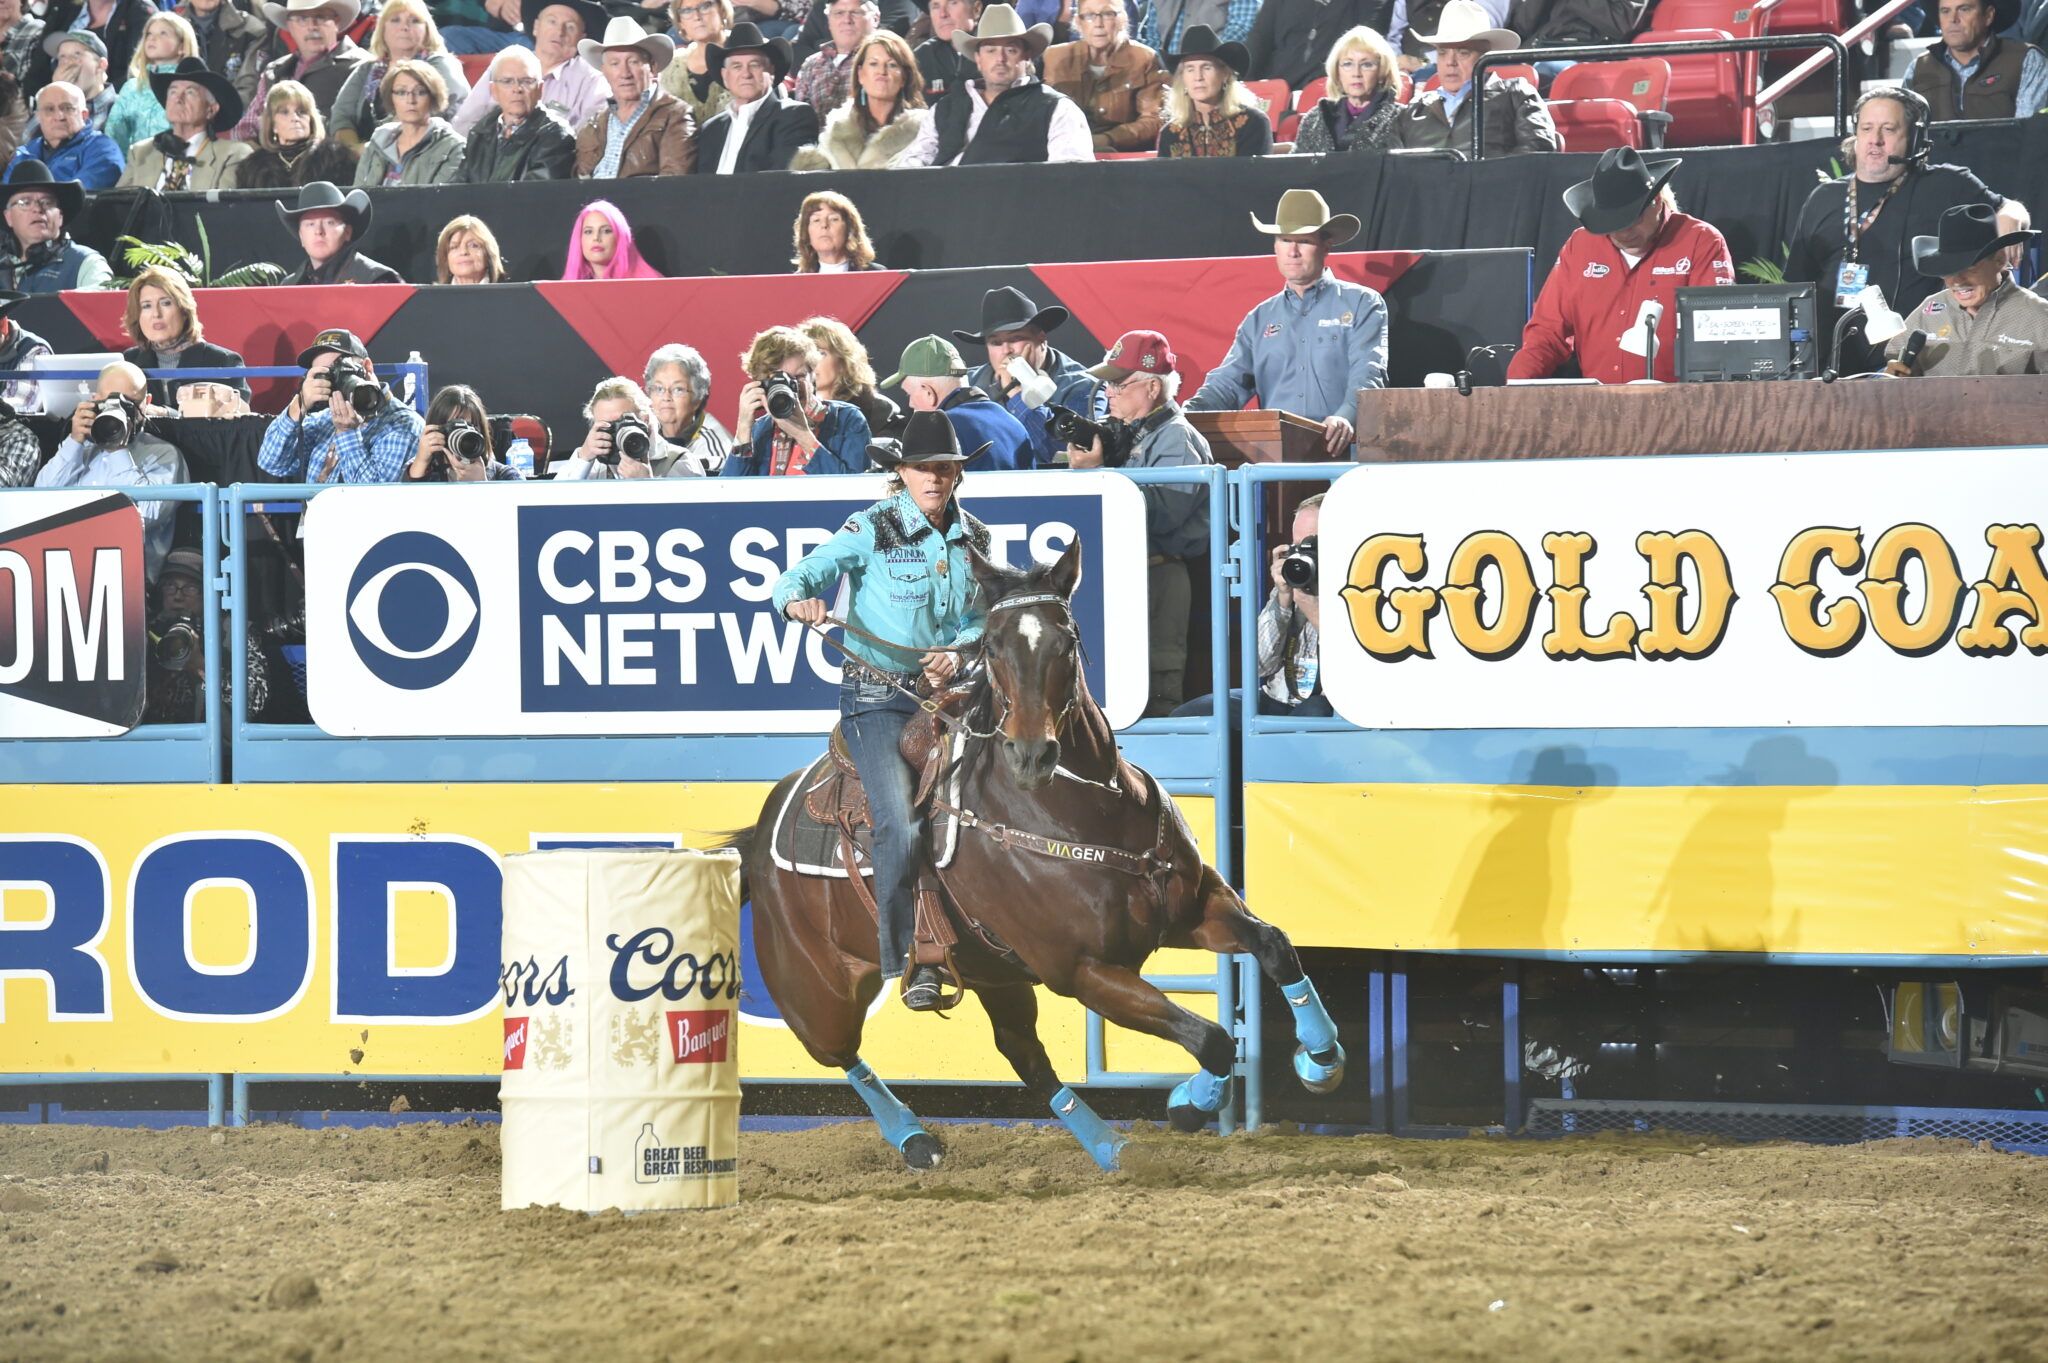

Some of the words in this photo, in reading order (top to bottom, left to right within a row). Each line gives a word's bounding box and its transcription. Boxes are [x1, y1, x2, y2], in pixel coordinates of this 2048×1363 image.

[538, 528, 706, 604] CBS
[1338, 529, 1740, 663] GOLD
[1047, 841, 1105, 862] VIAGEN
[677, 1017, 728, 1059] Banquet
[644, 1147, 680, 1162] GREAT
[683, 1146, 706, 1160] BEER
[644, 1161, 680, 1176] GREAT
